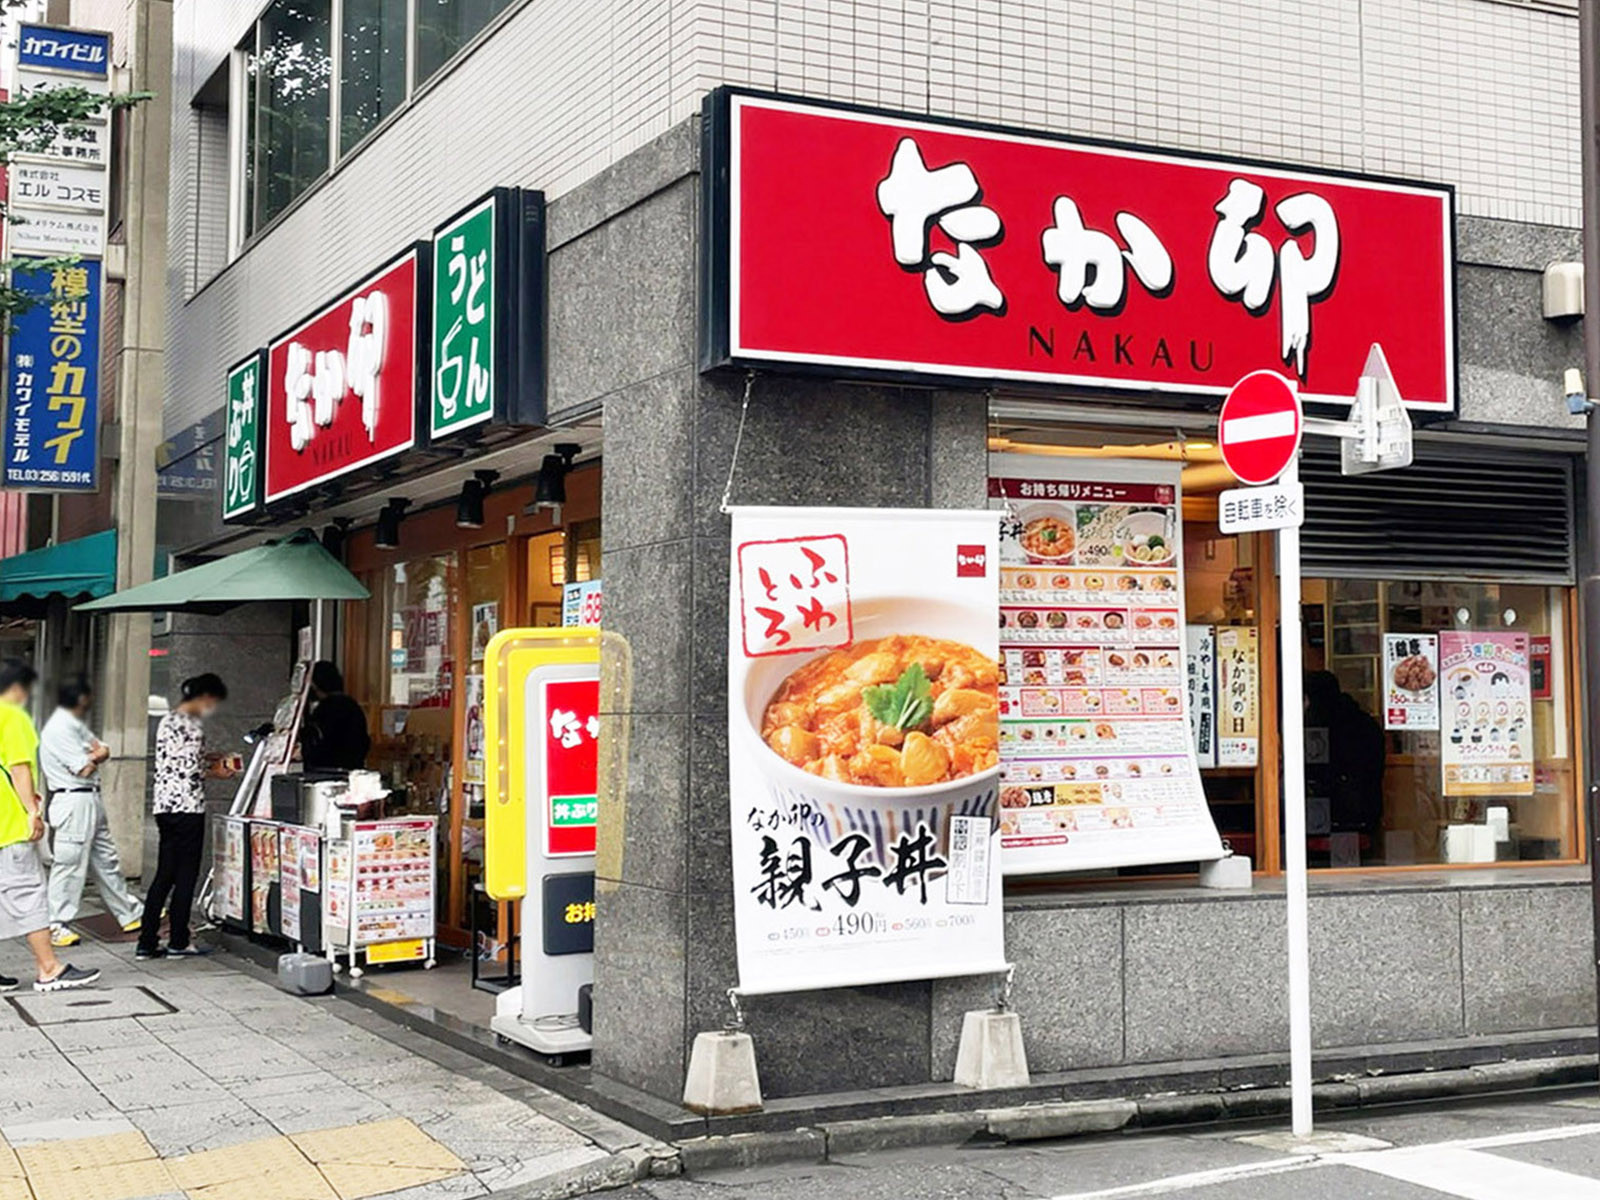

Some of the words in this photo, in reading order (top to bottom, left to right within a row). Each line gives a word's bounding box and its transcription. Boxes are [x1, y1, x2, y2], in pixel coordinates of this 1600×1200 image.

[22, 36, 105, 63] カワイビル
[18, 169, 60, 182] 株式会社
[18, 182, 51, 198] エル
[57, 186, 101, 204] コスモ
[876, 137, 1342, 382] なか卯
[448, 235, 490, 409] うどん
[44, 267, 90, 464] 模型のカワイ
[1029, 325, 1215, 372] NAKAU
[284, 290, 389, 455] なか卯
[1020, 482, 1127, 498] お持ち帰りメニュー
[1224, 494, 1298, 525] 自転車を除く
[747, 803, 825, 832] なか卯の
[750, 824, 947, 912] 親子丼
